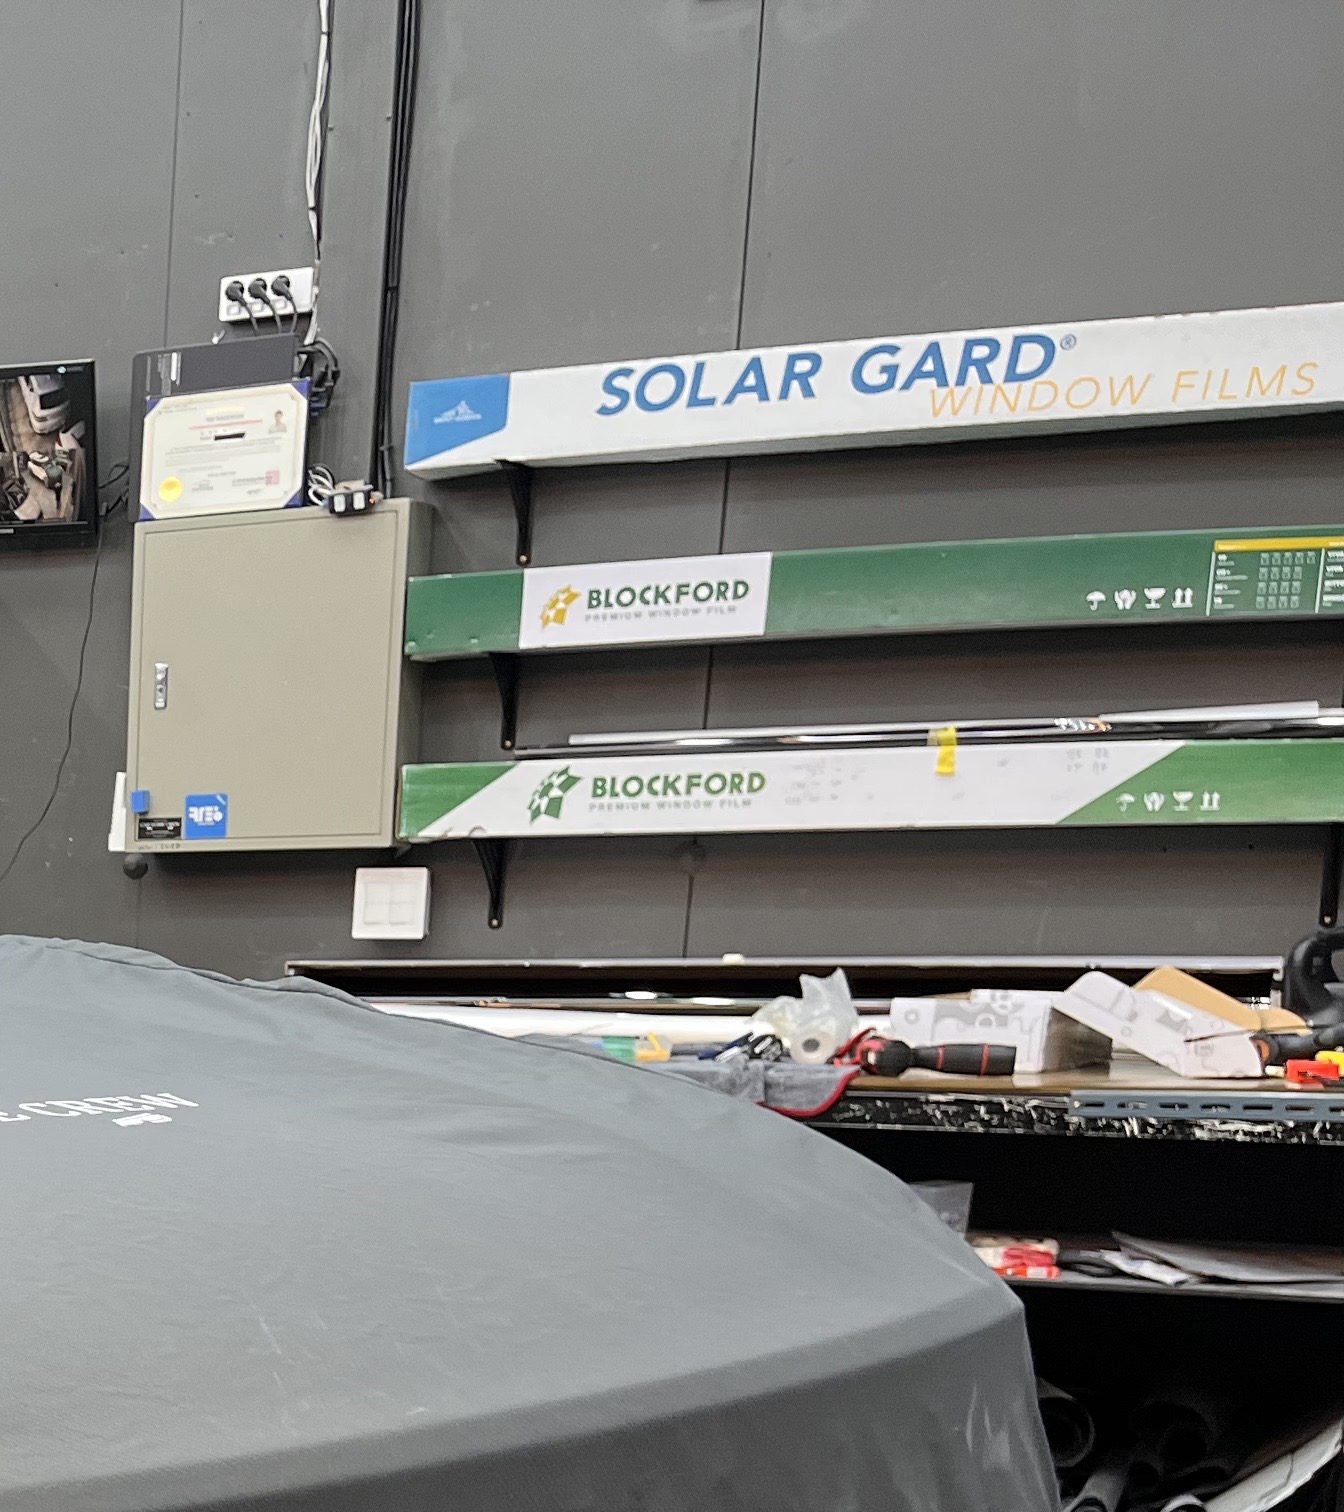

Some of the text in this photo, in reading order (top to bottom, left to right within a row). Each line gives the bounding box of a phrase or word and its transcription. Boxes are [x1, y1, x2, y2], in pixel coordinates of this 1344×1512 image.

[596, 351, 822, 416] SOLAR
[928, 361, 1320, 418] WINDOW FILMS
[587, 579, 750, 610] BLOCKFORD
[591, 771, 768, 799] BLOCKFORD
[18, 1092, 200, 1117] CREW
